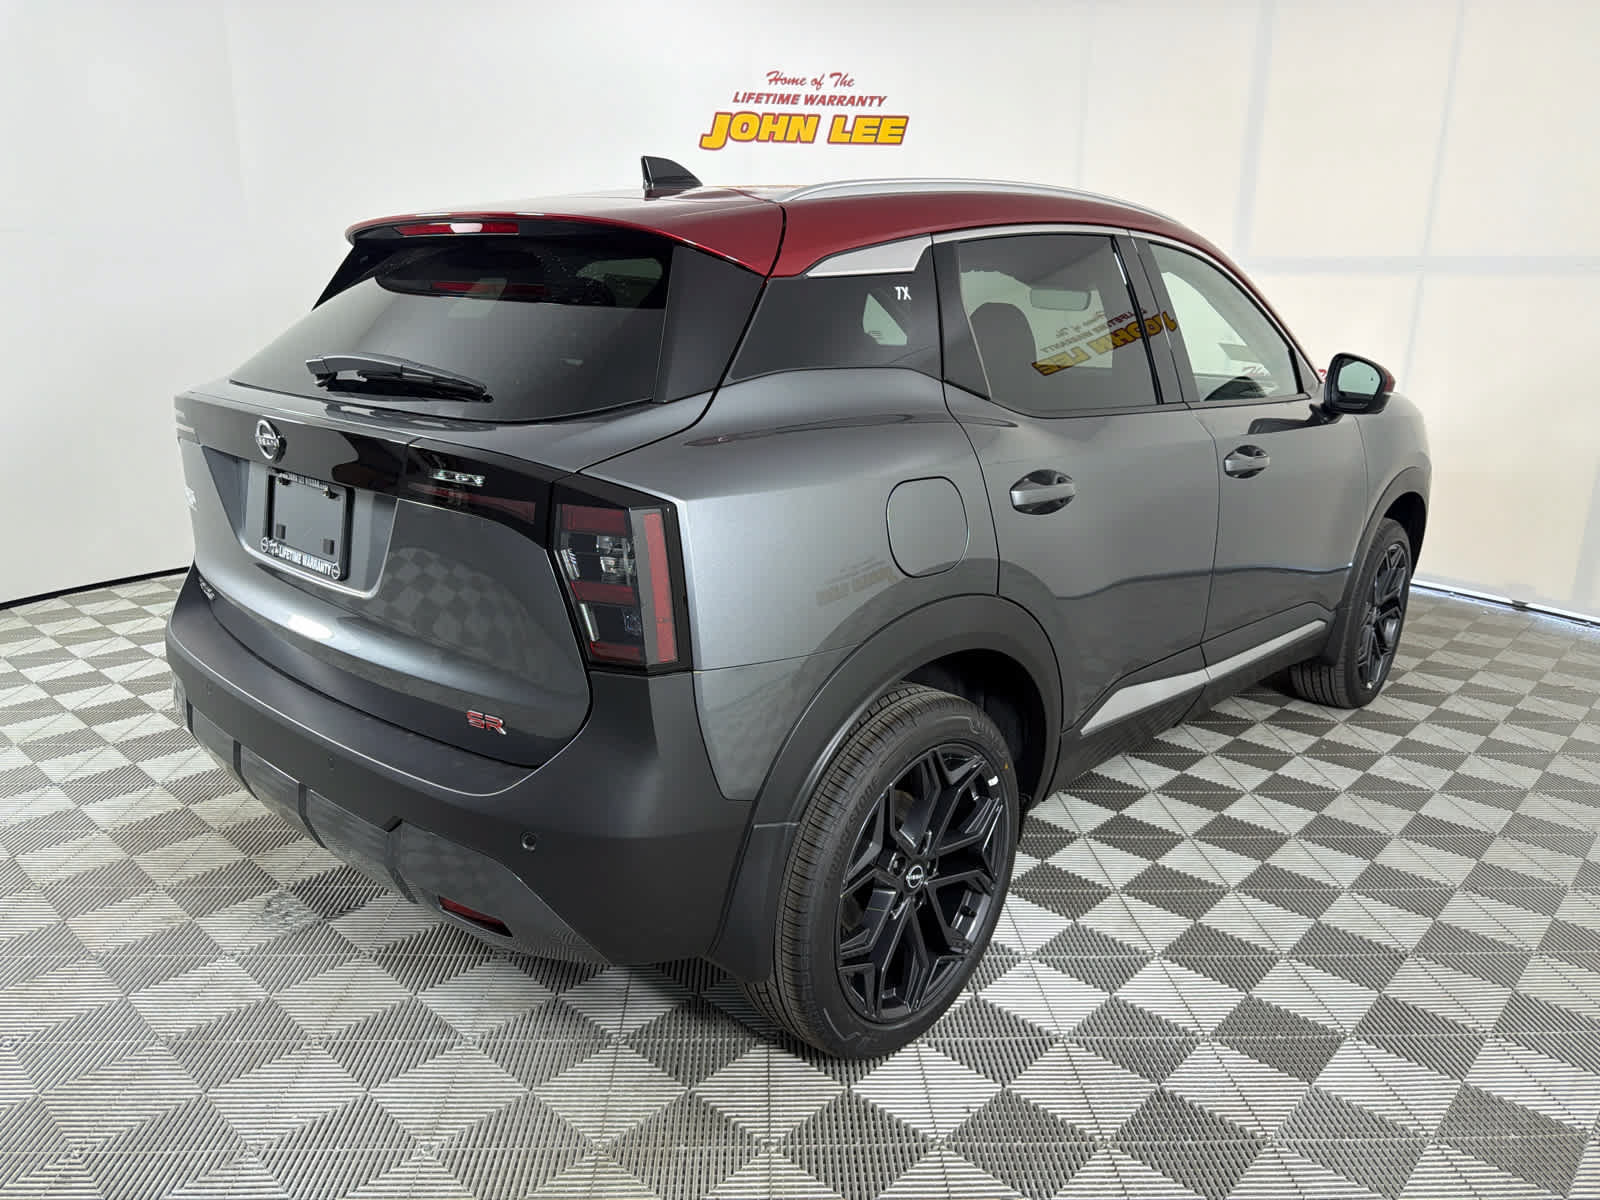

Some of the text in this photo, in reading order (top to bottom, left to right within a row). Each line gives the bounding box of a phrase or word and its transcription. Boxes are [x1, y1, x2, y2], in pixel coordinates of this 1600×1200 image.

[765, 70, 855, 90] Home of The
[732, 91, 887, 107] LIFETIME WARRANTY
[699, 111, 909, 151] JOHN LEE
[893, 286, 912, 301] TX
[279, 544, 302, 564] LIFETIME
[302, 553, 332, 575] WARRANTY
[466, 710, 507, 735] SR
